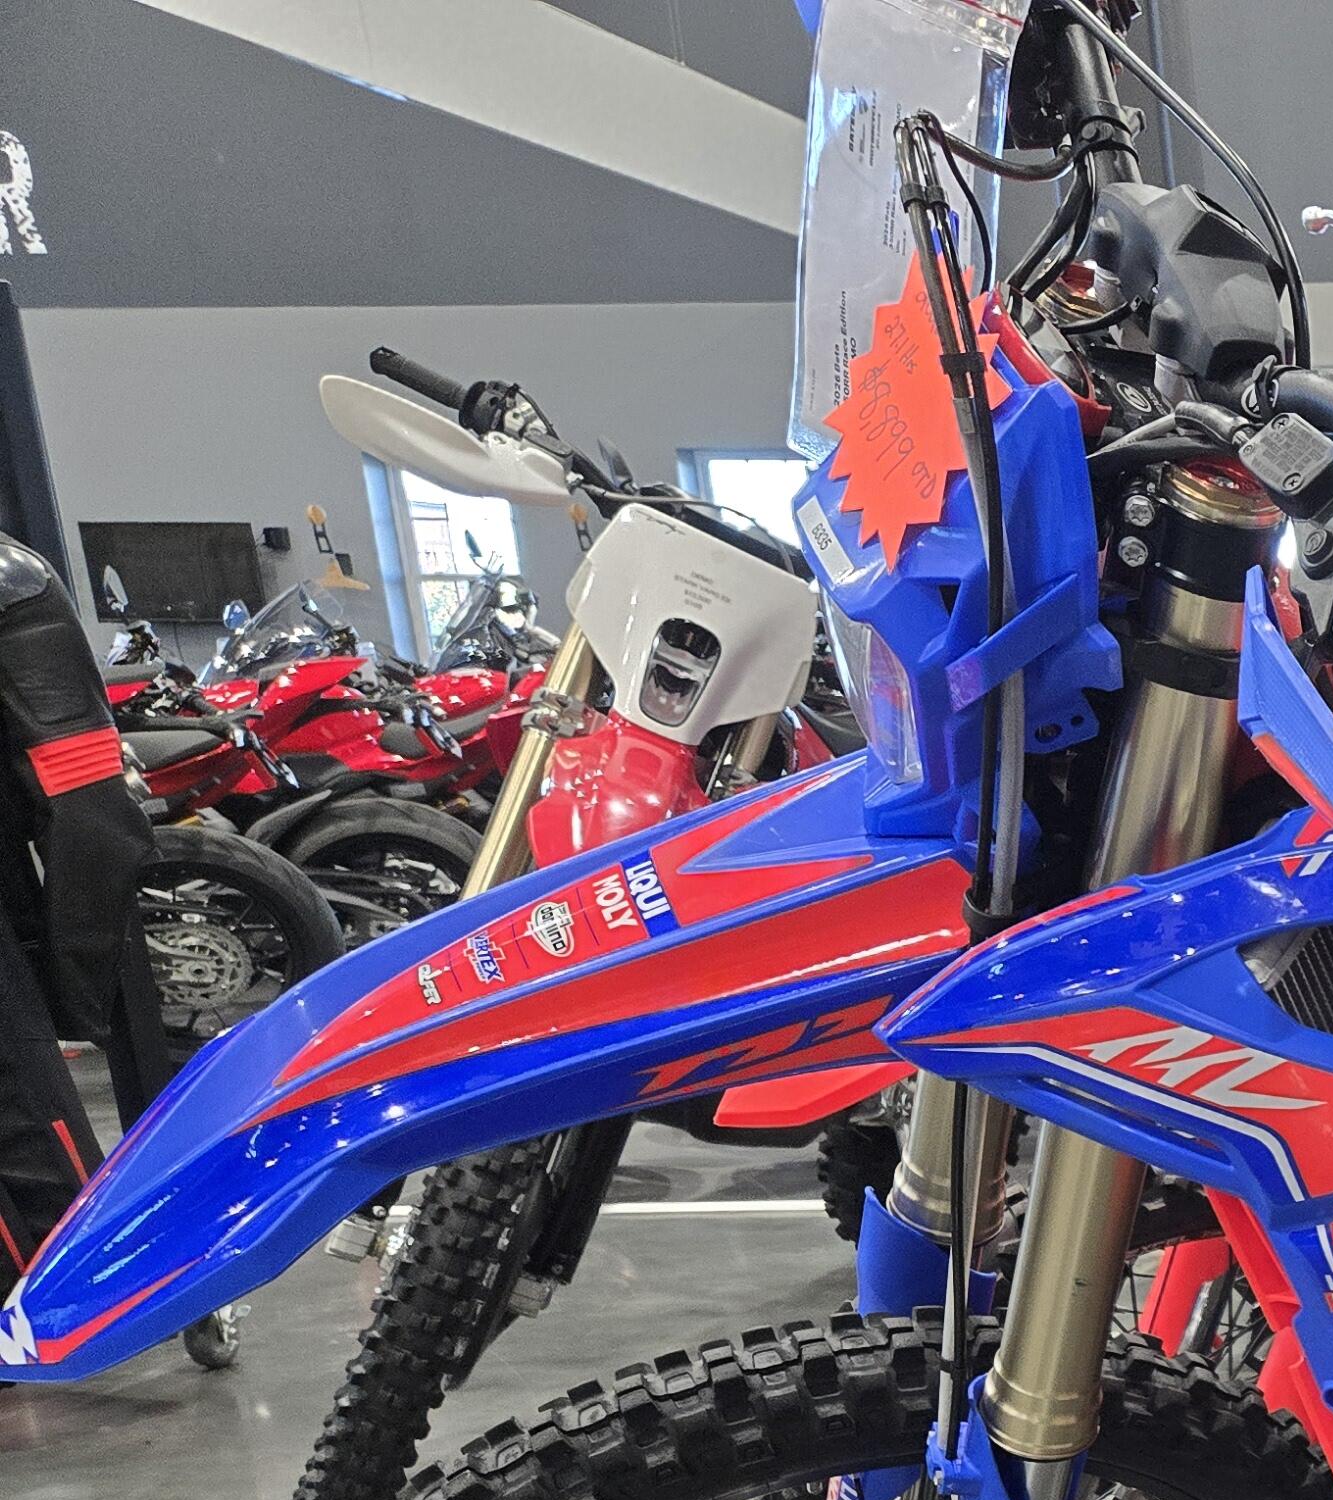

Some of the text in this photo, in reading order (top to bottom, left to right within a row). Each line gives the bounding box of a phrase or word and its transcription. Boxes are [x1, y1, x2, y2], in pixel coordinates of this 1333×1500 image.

[839, 290, 848, 336] Edition
[833, 343, 841, 373] Beta
[842, 338, 850, 369] Race
[592, 873, 638, 930] MOLY
[625, 860, 672, 921] LIQUI
[474, 931, 502, 980] VERTEX
